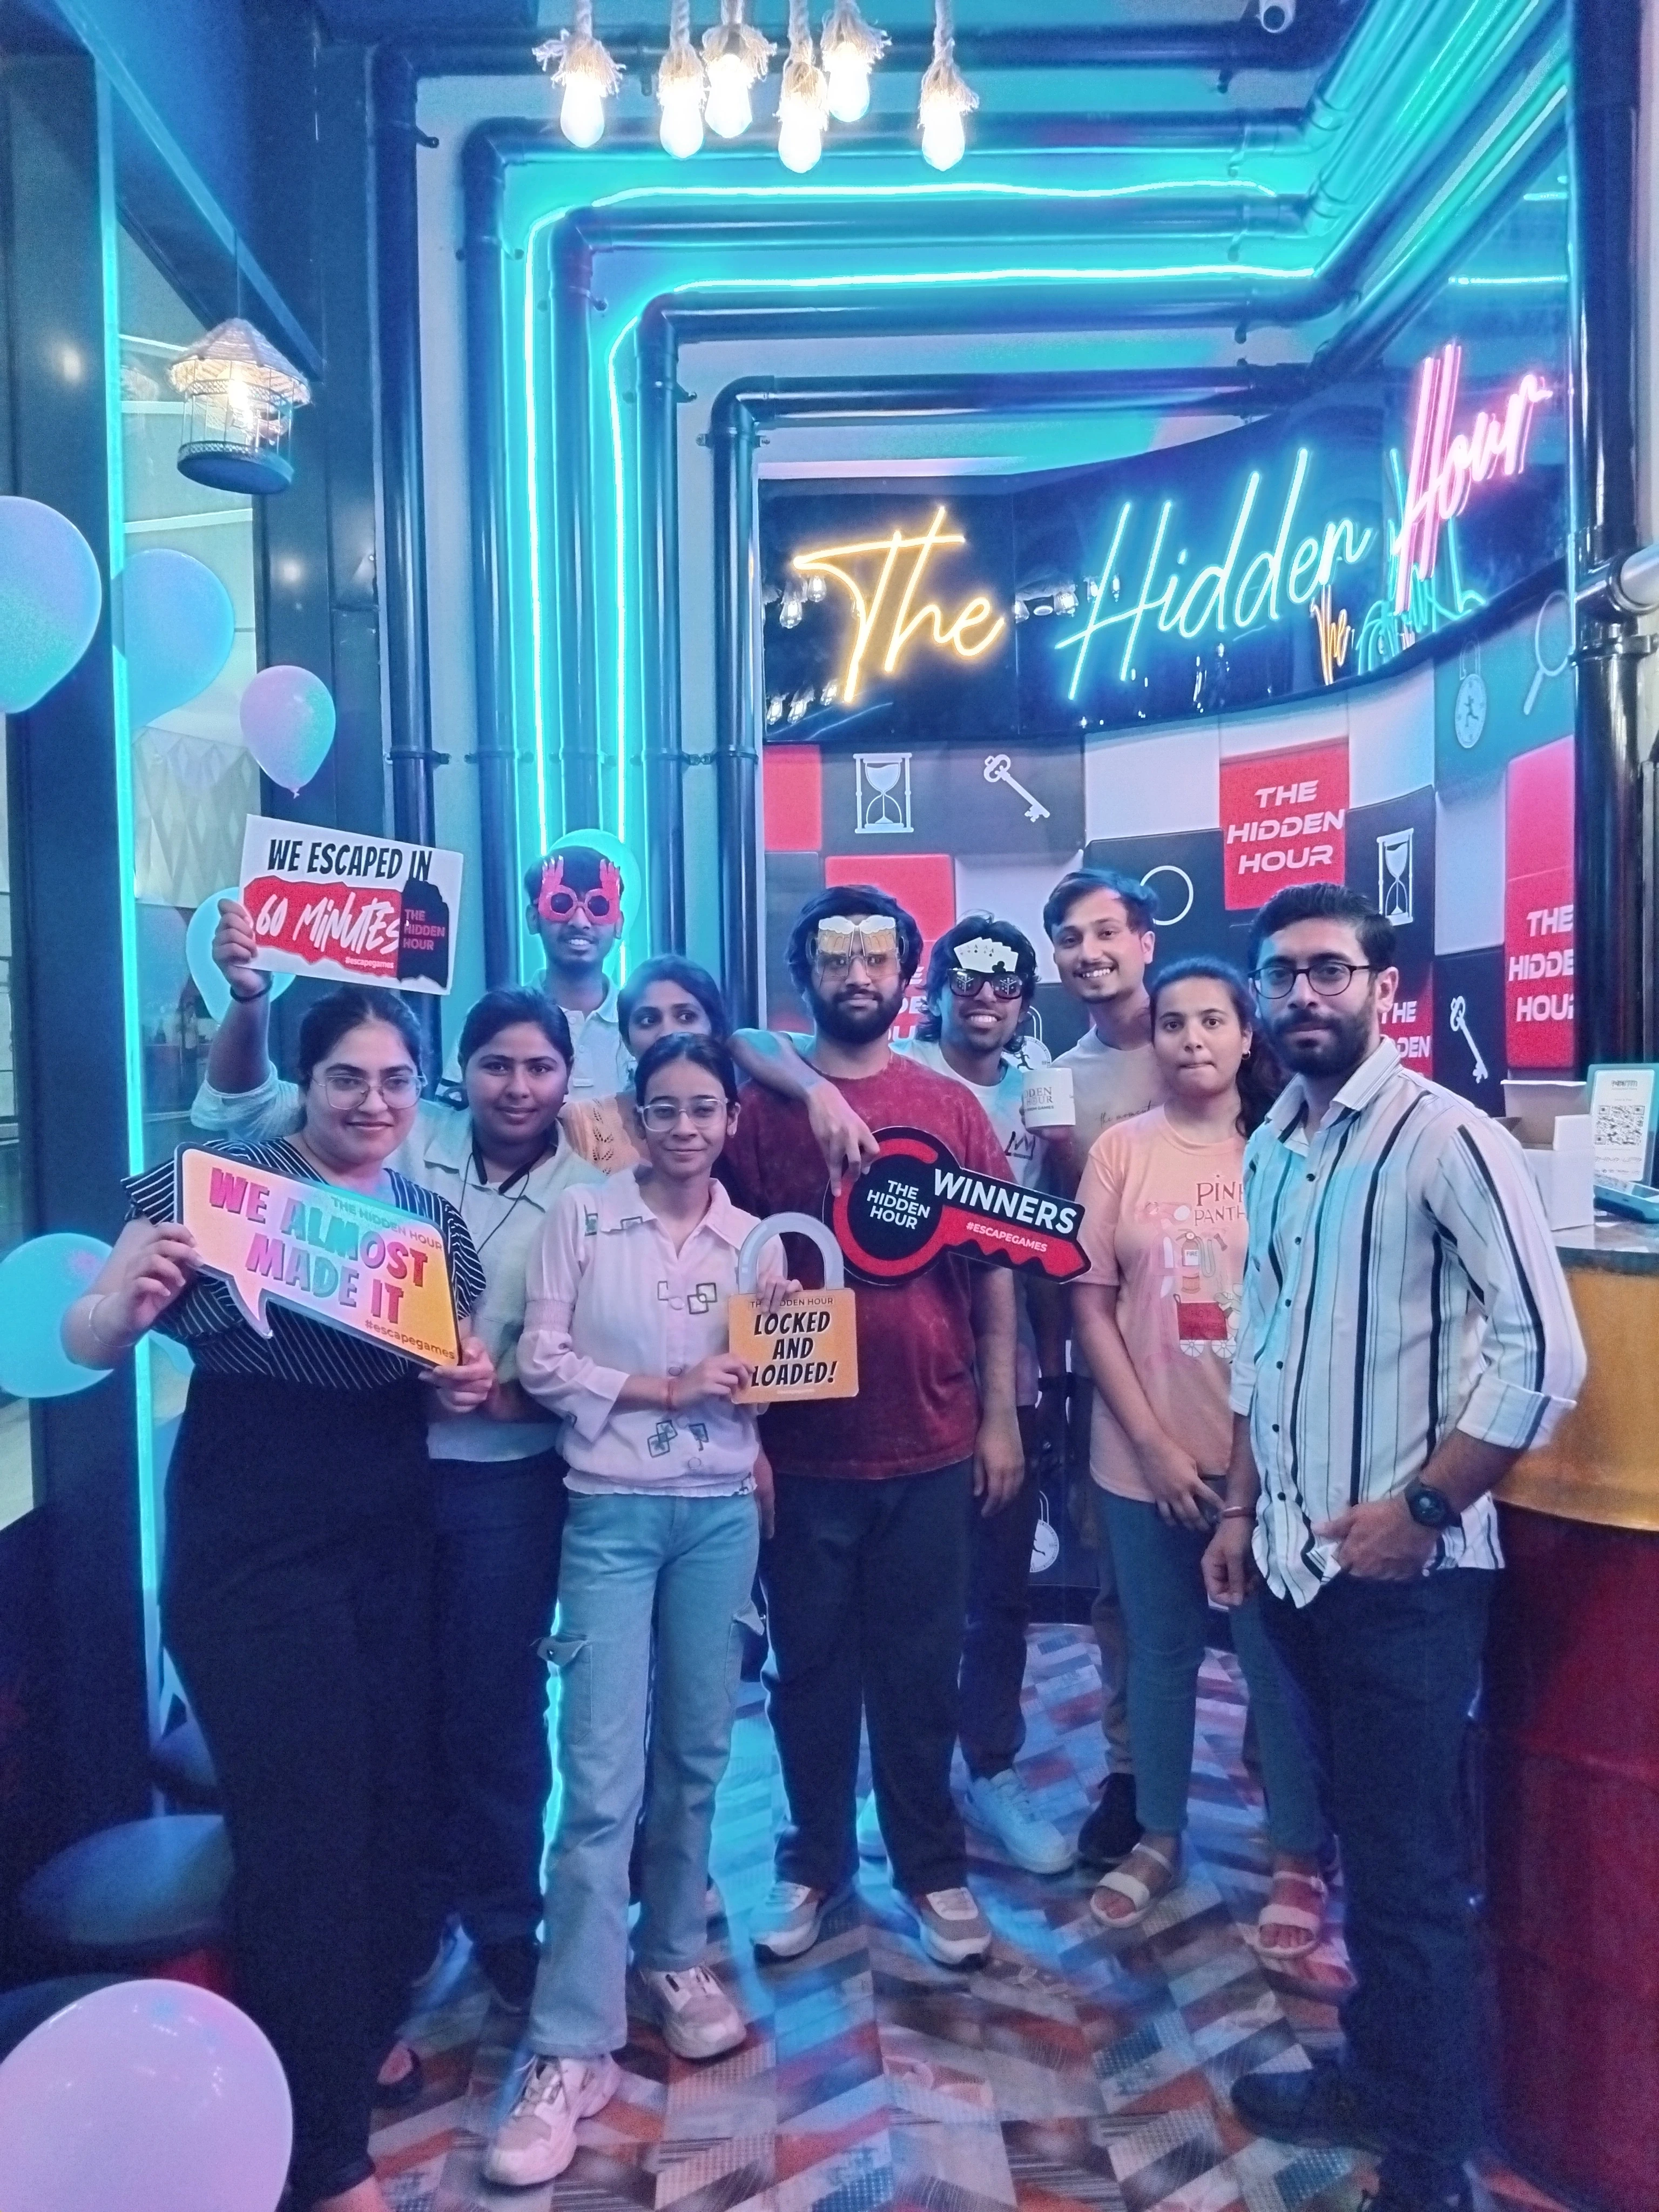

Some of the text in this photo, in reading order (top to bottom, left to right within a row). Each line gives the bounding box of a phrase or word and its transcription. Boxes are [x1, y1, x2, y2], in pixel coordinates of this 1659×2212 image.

[793, 507, 1004, 703] The
[1055, 449, 1372, 700] Hidden
[1392, 344, 1553, 616] Hour
[1255, 779, 1319, 808] THE
[1226, 808, 1345, 844] HIDDEN
[267, 839, 433, 882] WE ESCAPED IN
[1238, 844, 1334, 875] HOUR
[255, 893, 288, 937] 60
[404, 908, 426, 922] THE
[1526, 904, 1574, 937] THE
[402, 939, 435, 951] HOUR
[403, 924, 446, 938] HIDDEN
[345, 955, 394, 969] #escapegames
[1508, 948, 1574, 981] HIDDE
[1396, 1035, 1431, 1058] DEN
[1024, 1087, 1053, 1099] DDEN
[1026, 1095, 1054, 1106] HOUR
[866, 1189, 930, 1219] HIDDEN
[887, 1179, 919, 1201] THE
[934, 1168, 1077, 1235] WINNERS
[209, 1166, 428, 1287] WE ALMOST
[331, 1196, 443, 1251] THE HIDDEN HOUR
[869, 1205, 919, 1230] HOUR
[1194, 1205, 1245, 1226] PANTH
[966, 1221, 1048, 1253] #ESCAPEGAMES
[245, 1232, 404, 1325] MADE IT
[780, 1298, 805, 1306] DDEN
[808, 1297, 833, 1305] HOUR
[753, 1311, 831, 1336] LOCKED
[365, 1319, 455, 1360] #escapegames
[772, 1337, 813, 1360] AND
[751, 1360, 838, 1387] LOADED!
